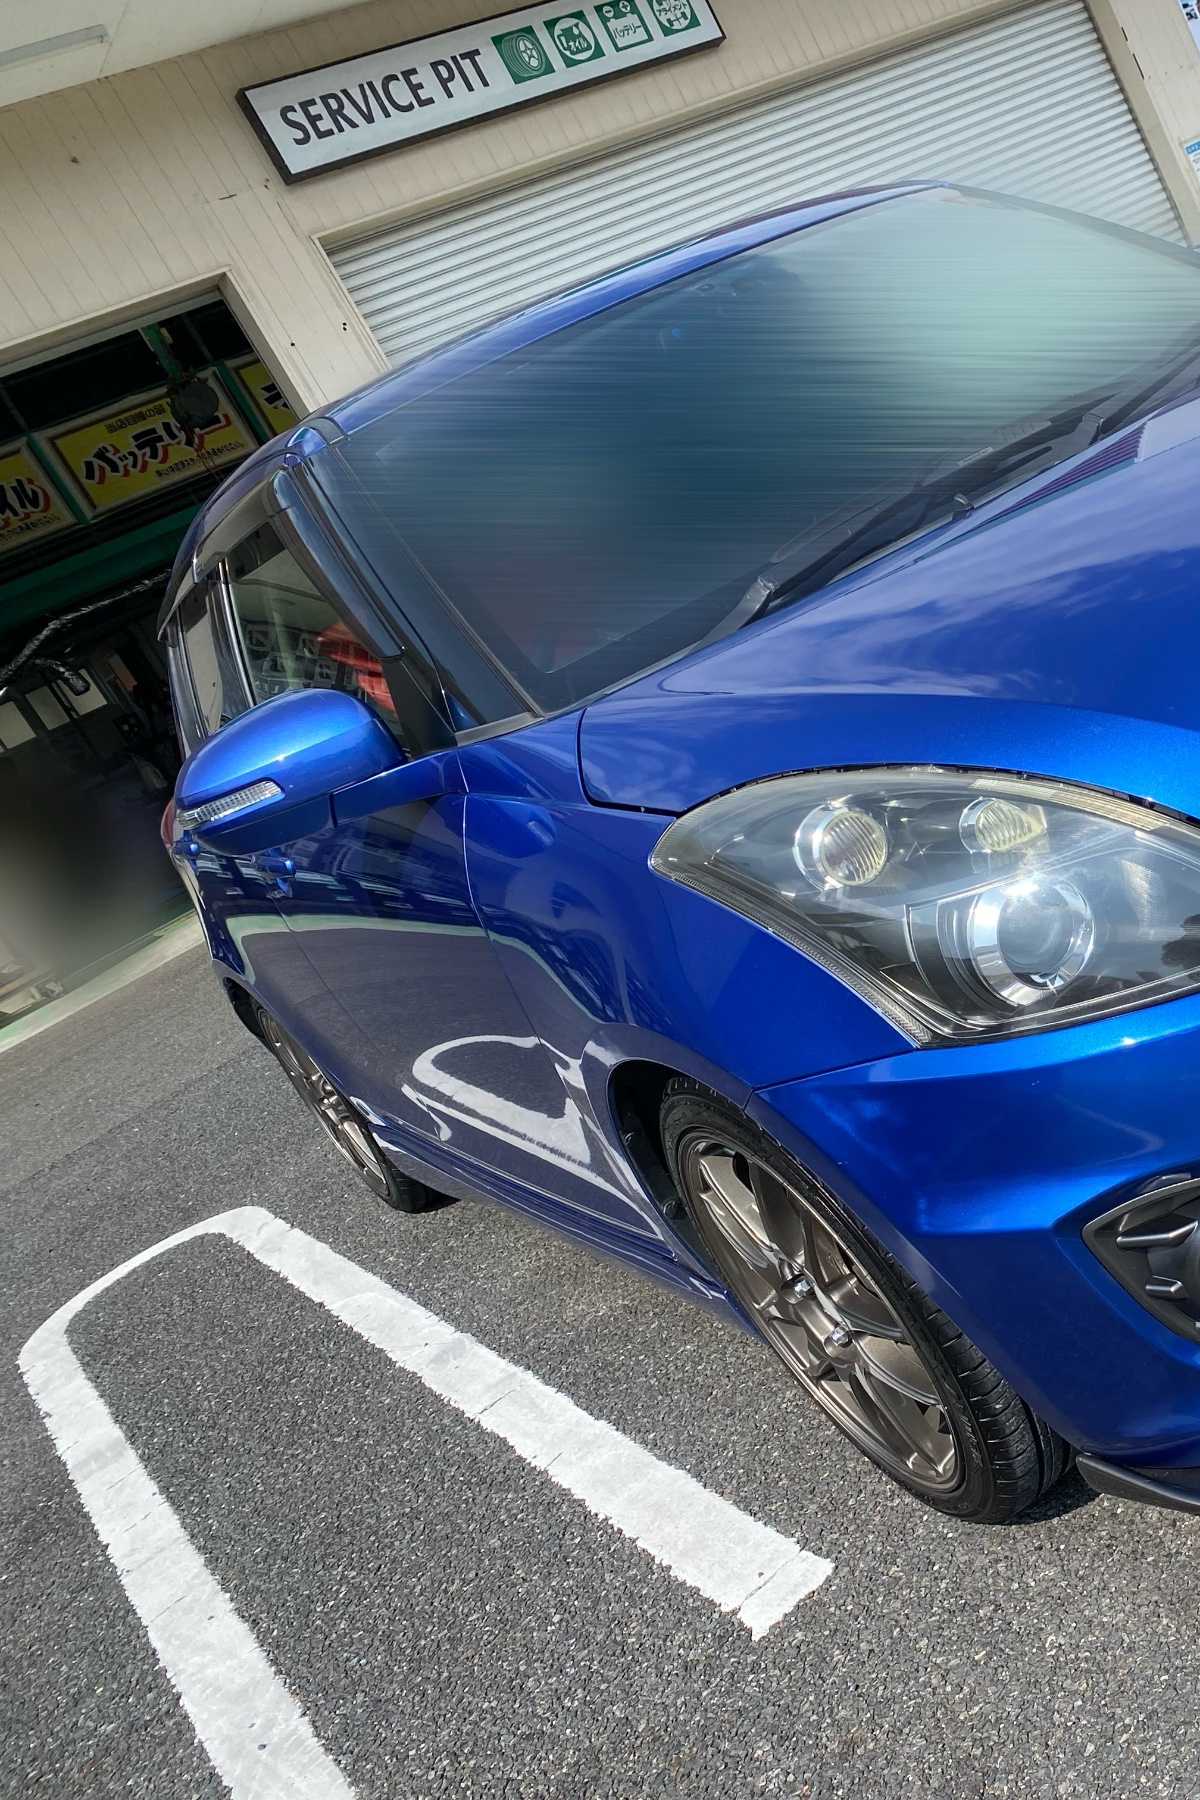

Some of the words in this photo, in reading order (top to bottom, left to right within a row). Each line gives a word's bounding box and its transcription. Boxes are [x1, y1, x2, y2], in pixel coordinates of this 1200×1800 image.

[656, 1, 688, 17] アライメント
[612, 22, 642, 40] バッテリー
[569, 37, 588, 51] オイル
[280, 67, 436, 146] SERVICE
[429, 48, 490, 99] PIT
